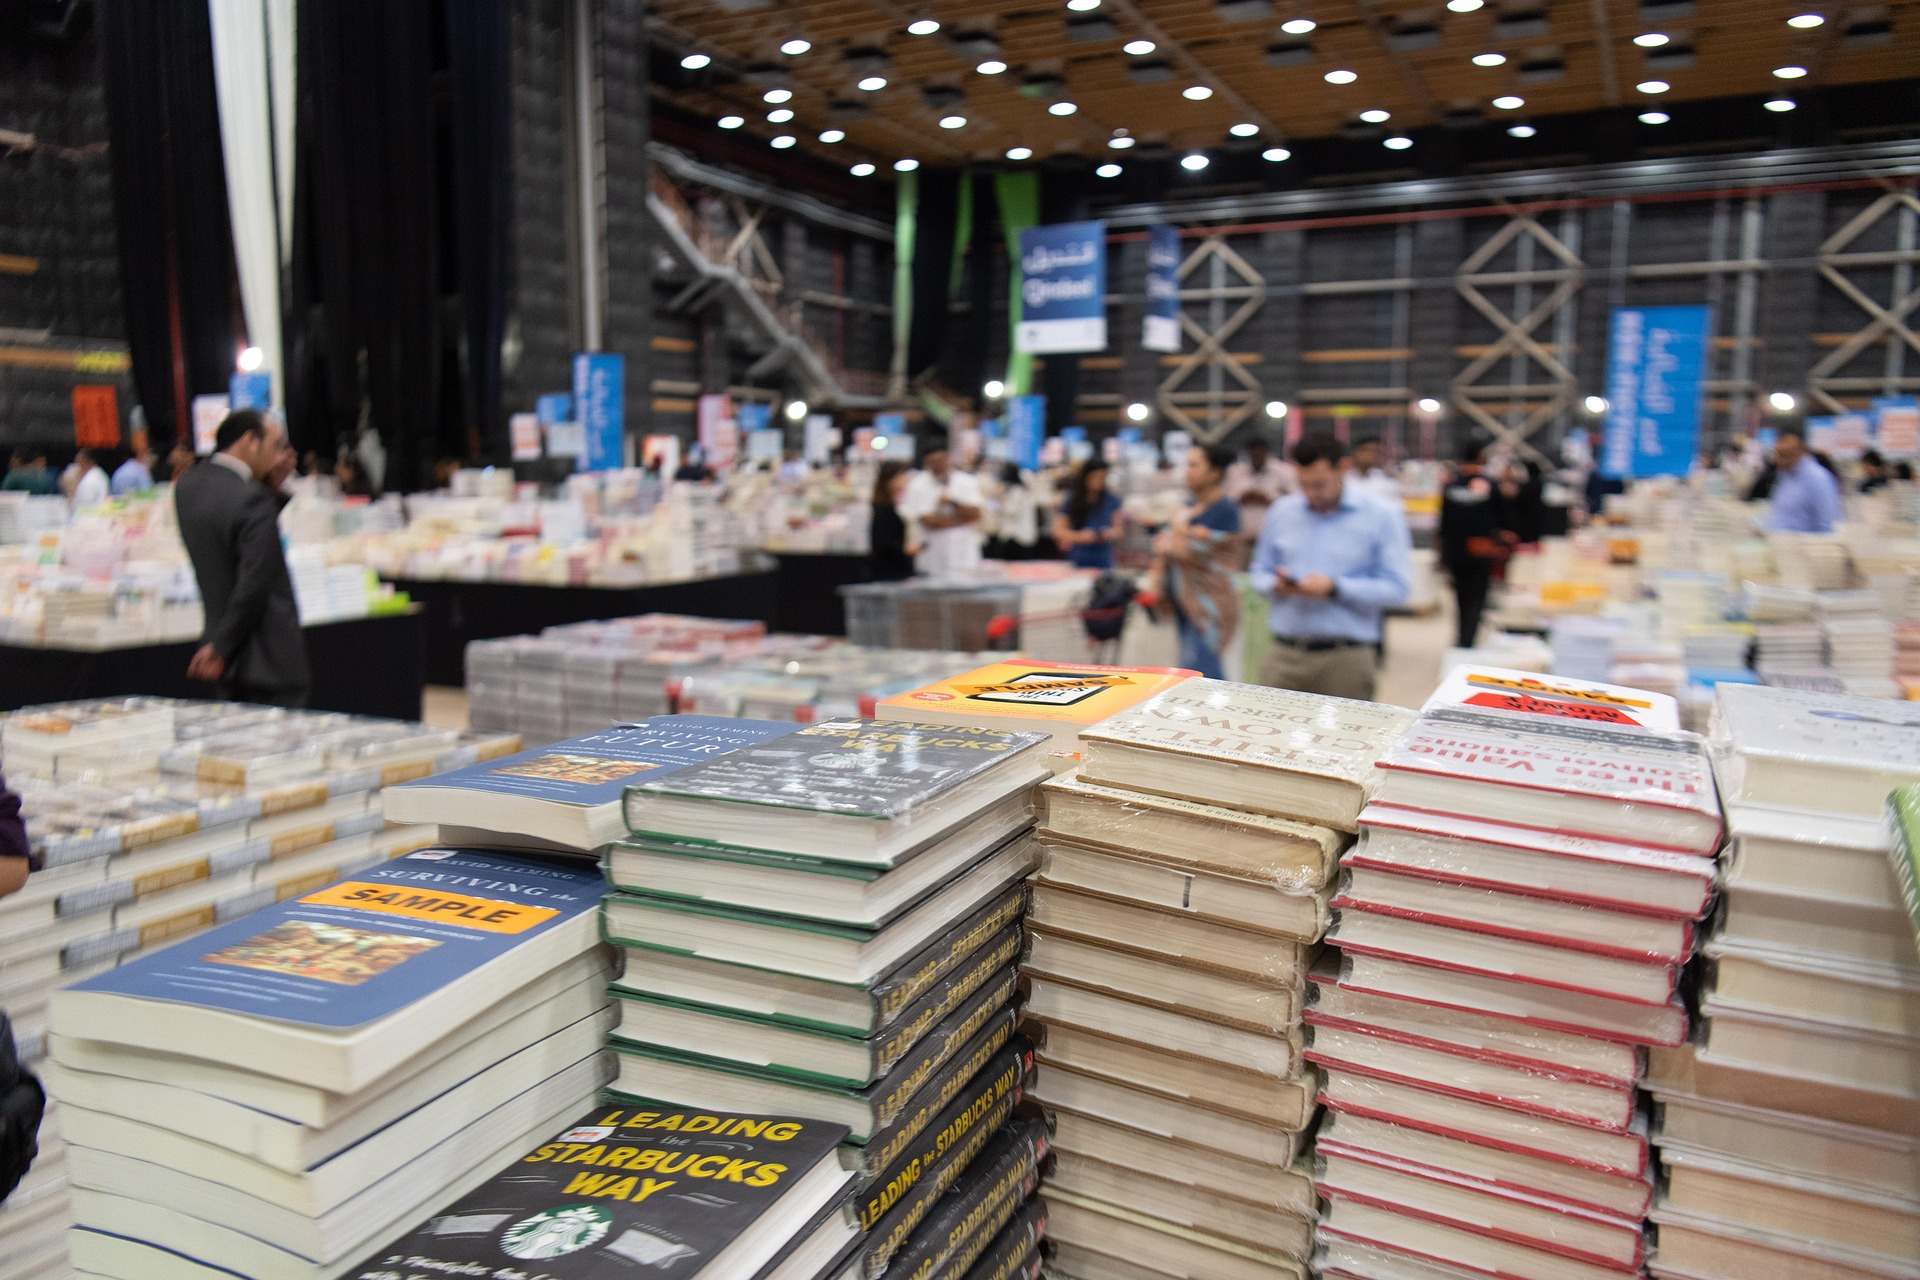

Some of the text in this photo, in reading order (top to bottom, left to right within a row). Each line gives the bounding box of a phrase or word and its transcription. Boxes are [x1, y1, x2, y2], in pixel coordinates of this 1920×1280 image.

[974, 679, 1109, 692] SAMPLE
[1488, 678, 1626, 704] SAMPLE
[848, 718, 1014, 737] LEADING
[1155, 694, 1390, 736] LEDERSHIP
[611, 728, 747, 744] SURVIVING
[796, 727, 1014, 751] STARBUCKS
[1408, 744, 1698, 794] Three Value
[1415, 735, 1702, 782] Conversations
[371, 869, 580, 901] SURVIVING the
[493, 863, 577, 880] FLEMING
[341, 888, 522, 924] SAMPLE
[951, 908, 1001, 966] STARBUCKS
[1002, 893, 1021, 923] WAY
[878, 1008, 933, 1066] LEADING
[946, 952, 997, 1010] STARBUCKS
[998, 935, 1016, 963] WAY
[944, 996, 994, 1057] STARBUCKS
[994, 977, 1012, 1007] WAY
[872, 1107, 927, 1178] LEADING
[941, 1040, 991, 1108] STARBUCKS
[991, 1020, 1010, 1054] WAY
[598, 1110, 804, 1142] LEADING
[660, 1135, 692, 1147] the
[522, 1142, 789, 1187] STARBUCKS
[860, 1157, 922, 1232] LEADING
[923, 1149, 936, 1167] the
[936, 1087, 994, 1158] STARBUCKS
[994, 1065, 1015, 1100] WAY
[560, 1171, 678, 1203] WAY
[870, 1199, 924, 1276] LEADING
[937, 1124, 988, 1195] STARBUCKS
[988, 1100, 1007, 1134] WAY
[949, 1178, 1007, 1249] STARBUCKS
[1007, 1152, 1028, 1195] WAY
[997, 1191, 1017, 1231] WAY
[1006, 1235, 1028, 1274] WAY
